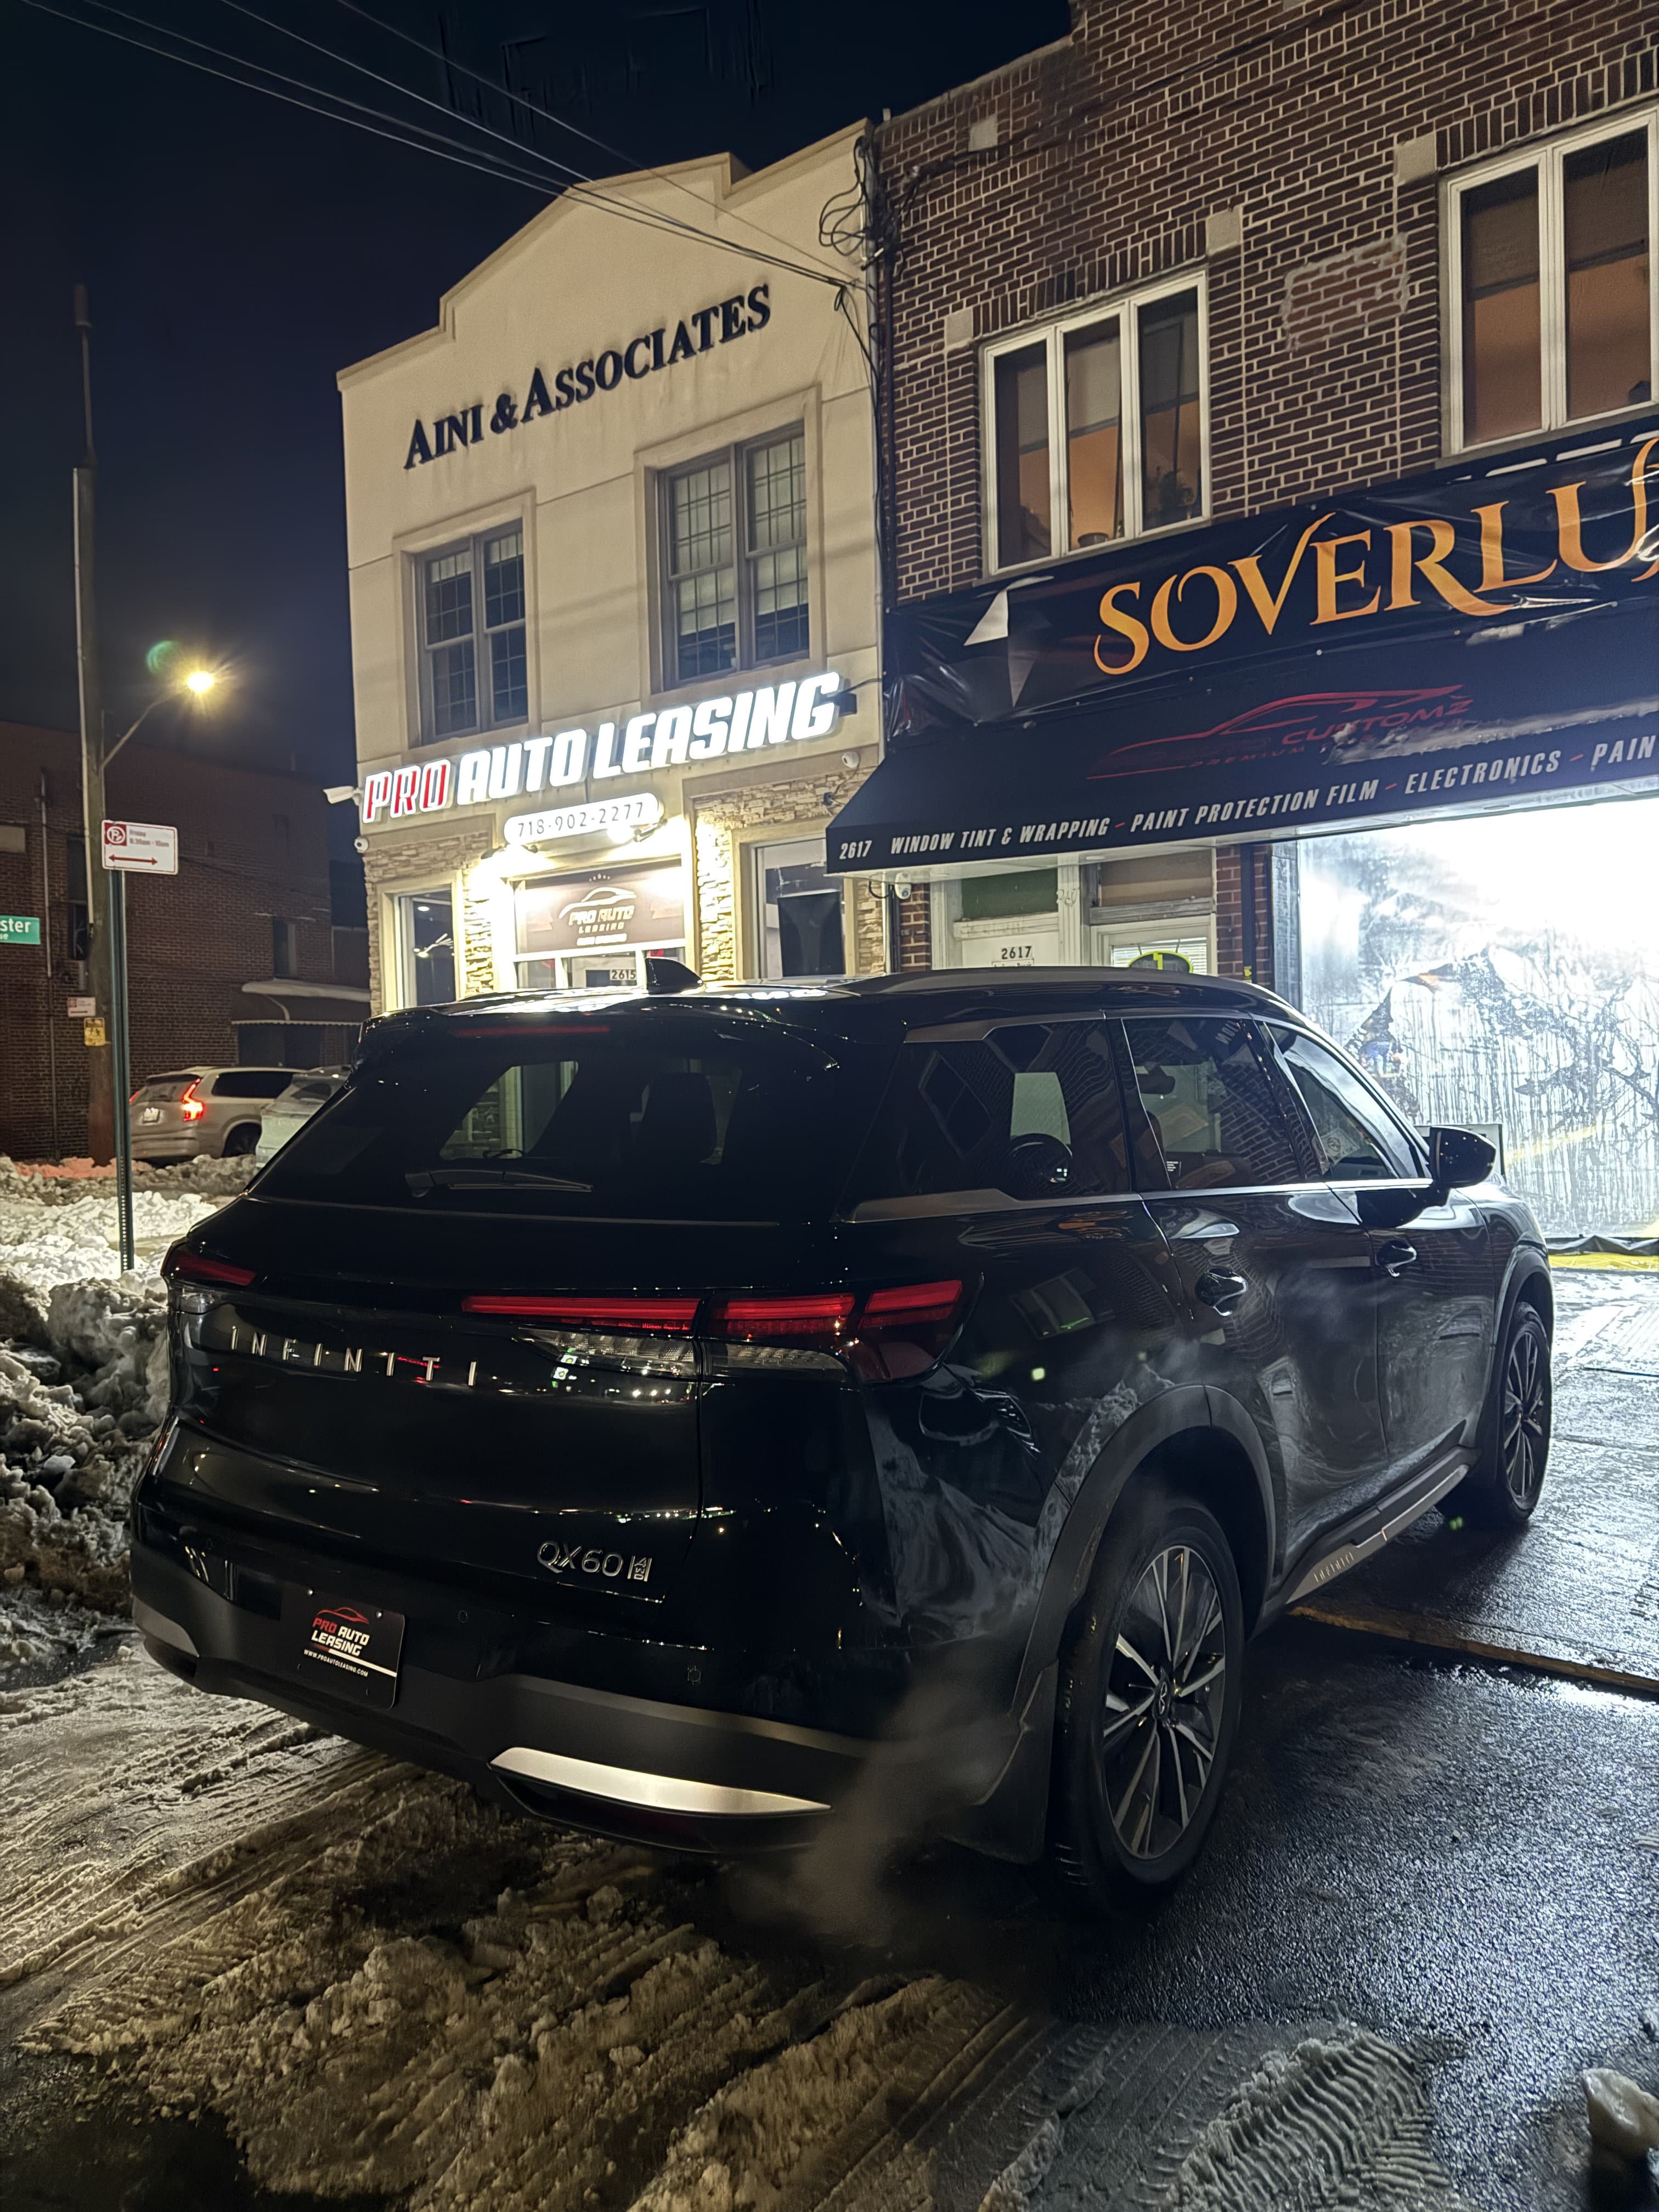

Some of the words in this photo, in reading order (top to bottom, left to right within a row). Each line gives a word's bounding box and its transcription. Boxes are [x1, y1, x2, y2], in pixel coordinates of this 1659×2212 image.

[403, 403, 483, 469] AINI
[489, 393, 519, 433] &
[521, 283, 771, 424] ASSOCIATES
[1093, 437, 1659, 675] SOVERLU
[363, 759, 451, 823] PRO
[456, 728, 587, 806] AUTO
[592, 671, 841, 780] LEASING
[518, 802, 643, 837] 718-902-2277
[839, 840, 872, 860] 2617
[890, 832, 955, 854] WINDOW
[960, 828, 996, 848] TINT
[1001, 827, 1012, 845] &
[1019, 817, 1110, 843] WRAPPING
[1130, 808, 1189, 832] PAINT
[1194, 789, 1319, 825] PROTECTION
[1325, 779, 1379, 806] FILM
[1404, 751, 1561, 794] ELECTRONICS
[568, 910, 597, 926] PRO
[597, 905, 634, 922] AUTO
[1001, 946, 1032, 960] 2617
[611, 969, 636, 979] 2615
[230, 1325, 477, 1387] INFINITI
[537, 1541, 623, 1577] QX60
[311, 1630, 362, 1656] LEASING
[312, 1617, 337, 1634] PRO
[337, 1626, 370, 1646] AUTO
[303, 1649, 369, 1677] WWW.PROAUTOLEASING.COM
